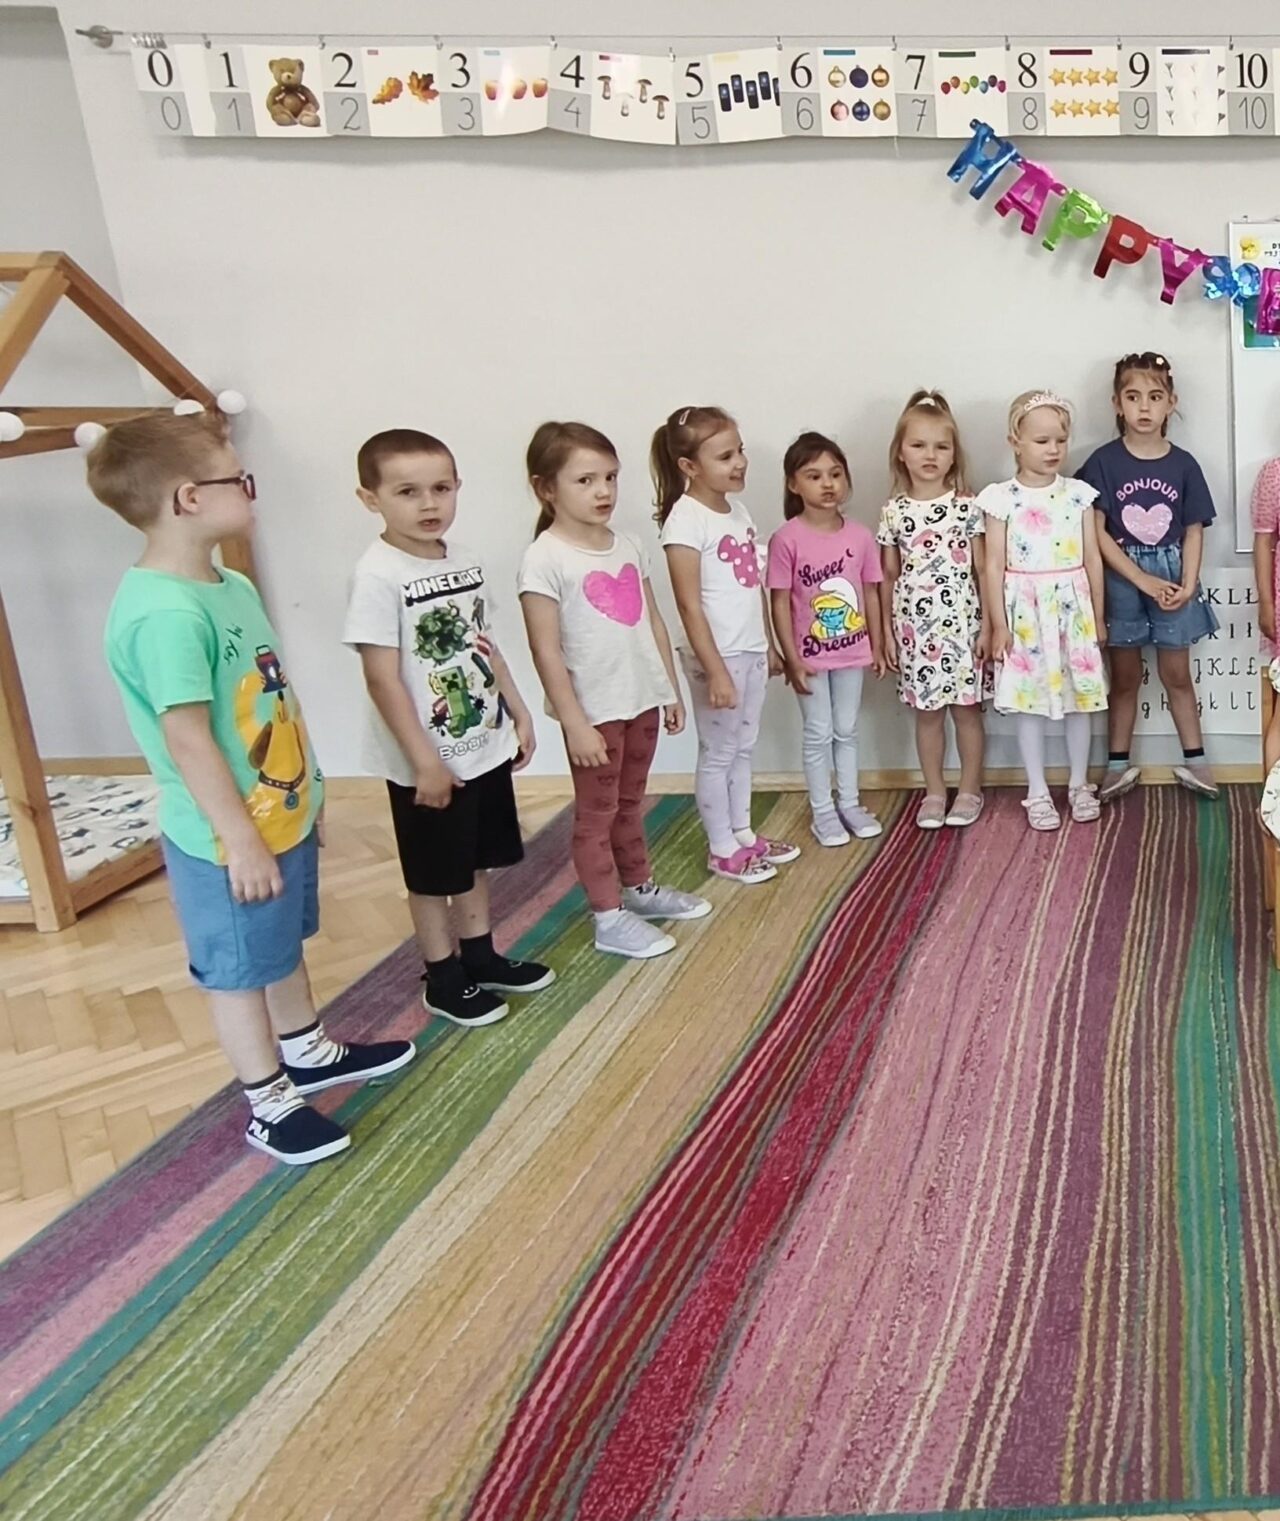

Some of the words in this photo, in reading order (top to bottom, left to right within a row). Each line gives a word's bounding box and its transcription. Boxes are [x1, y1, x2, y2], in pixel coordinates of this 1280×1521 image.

[147, 49, 173, 87] 0
[219, 51, 239, 88] 1
[332, 52, 357, 88] 2
[449, 52, 471, 88] 3
[560, 54, 585, 88] 4
[685, 62, 704, 98] 5
[790, 52, 812, 88] 6
[905, 54, 926, 90] 7
[1018, 52, 1037, 88] 8
[1129, 52, 1150, 88] 9
[1235, 53, 1268, 88] 10
[161, 96, 181, 130] 0
[227, 97, 241, 131] 1
[340, 97, 361, 131] 2
[457, 97, 475, 131] 3
[564, 97, 581, 128] 4
[692, 106, 710, 139] 5
[796, 97, 814, 130] 6
[912, 98, 927, 132] 7
[1022, 97, 1038, 130] 8
[1133, 96, 1150, 130] 9
[1239, 96, 1267, 129] 10
[1115, 477, 1179, 503] BONJOUR
[798, 556, 844, 588] Sweet
